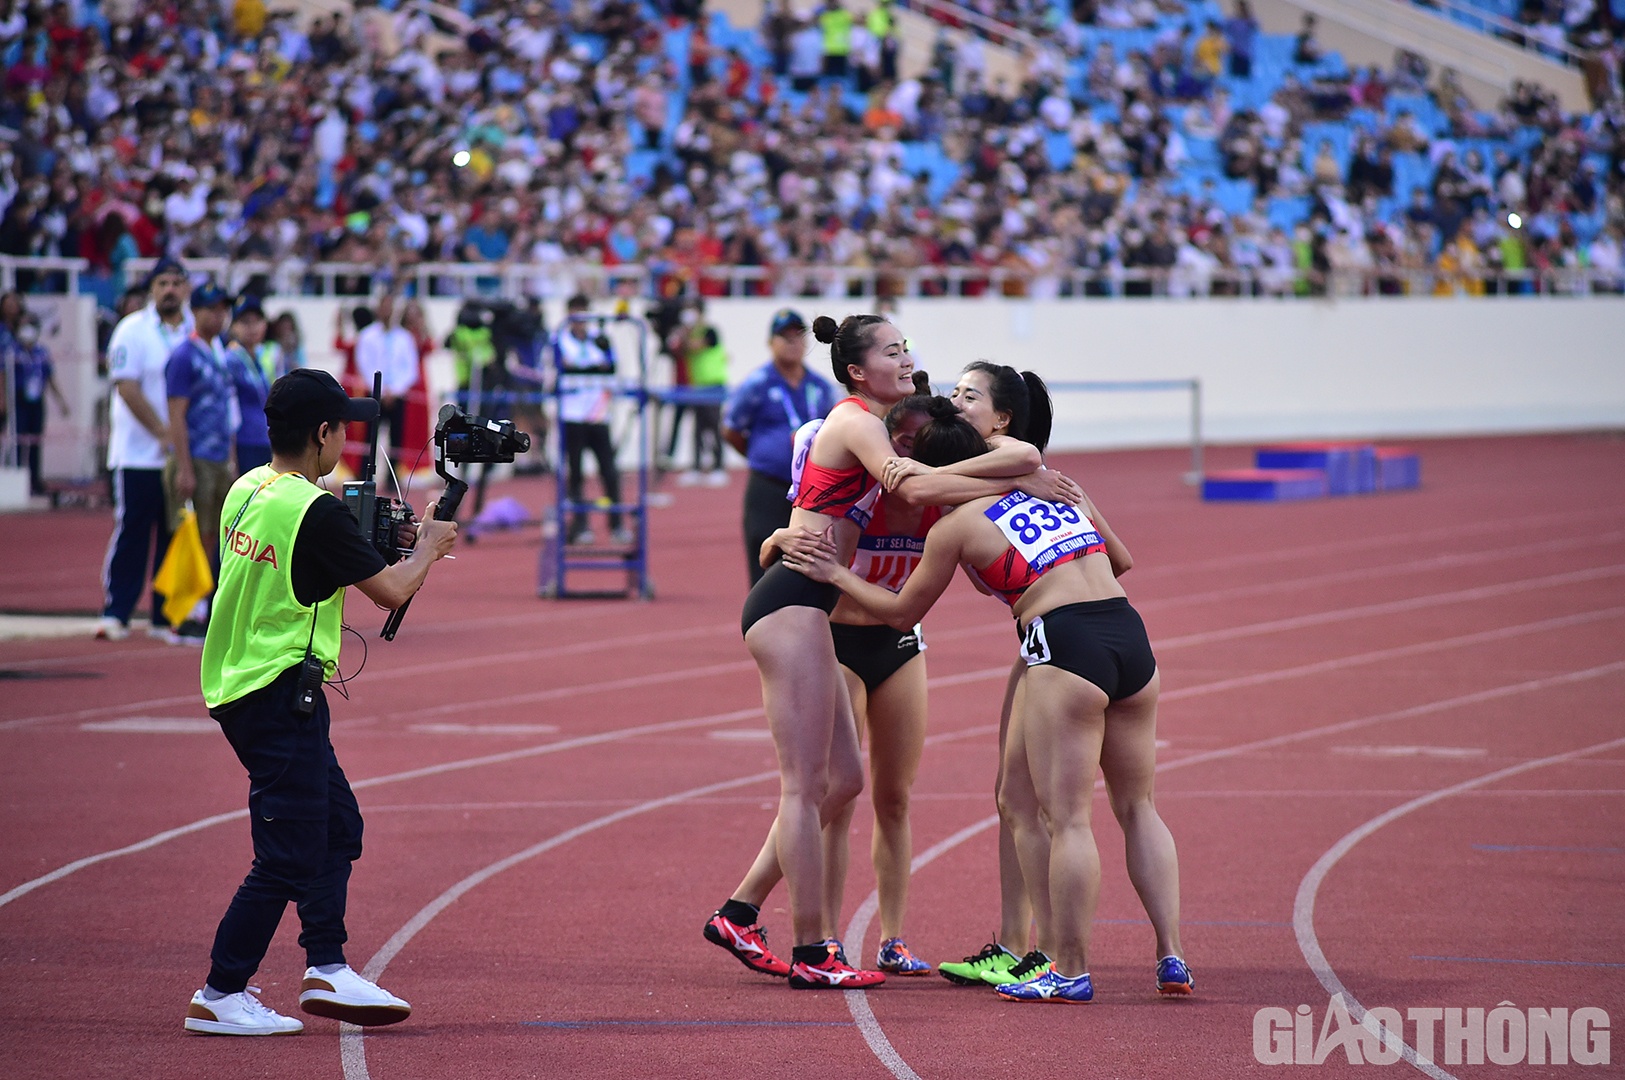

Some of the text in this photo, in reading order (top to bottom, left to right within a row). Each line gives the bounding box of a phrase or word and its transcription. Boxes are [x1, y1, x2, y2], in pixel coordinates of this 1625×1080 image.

[1009, 503, 1081, 545] 835
[1050, 531, 1073, 543] VIETNAM
[224, 525, 279, 570] MEDIA
[890, 538, 904, 549] SEA
[906, 538, 925, 550] Gam
[1058, 536, 1086, 553] VIETNAM
[1083, 533, 1099, 545] 2022
[1026, 623, 1045, 660] 4
